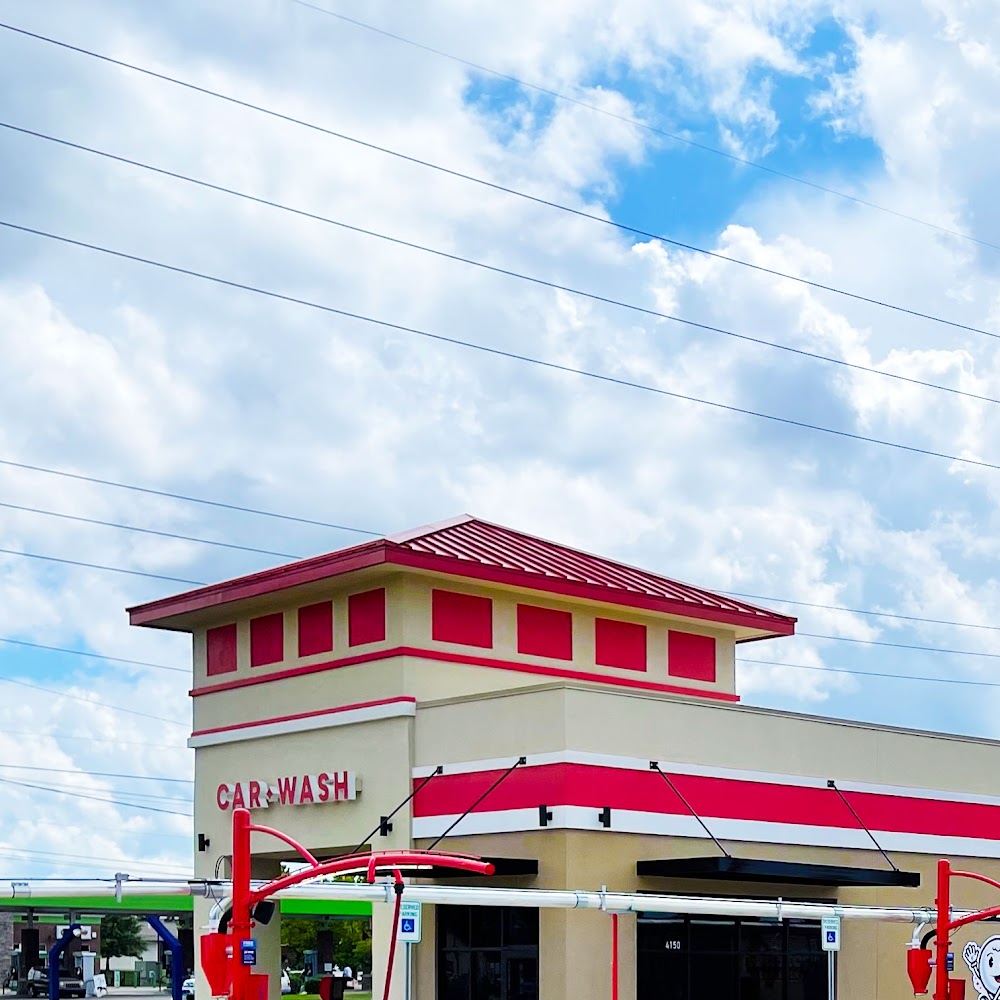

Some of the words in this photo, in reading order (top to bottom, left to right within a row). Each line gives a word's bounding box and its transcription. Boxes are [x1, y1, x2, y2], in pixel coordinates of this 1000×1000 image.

[216, 781, 261, 811] CAR
[277, 770, 349, 806] WASH
[665, 940, 681, 950] 4150
